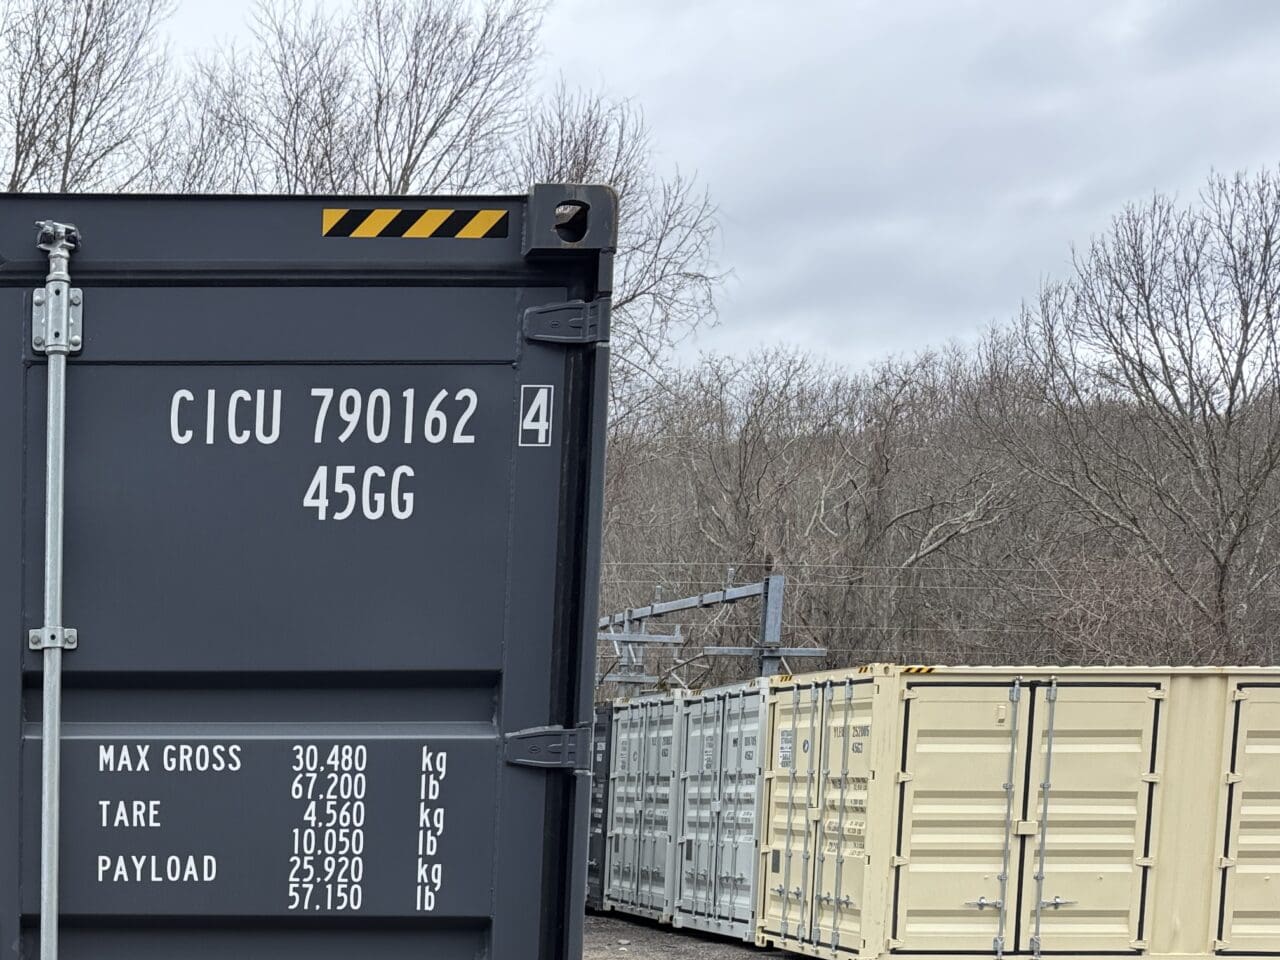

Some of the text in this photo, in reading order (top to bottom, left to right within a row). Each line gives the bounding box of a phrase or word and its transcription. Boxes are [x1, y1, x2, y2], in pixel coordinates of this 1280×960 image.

[170, 388, 549, 444] CICU 790162 4
[302, 465, 415, 520] 45GG
[98, 745, 150, 772] MAX
[162, 745, 242, 772] GROSS
[422, 746, 447, 780] kg
[420, 774, 440, 800] lb
[98, 800, 162, 827] TARE
[419, 802, 445, 836] kg
[418, 830, 437, 856] lb
[98, 855, 218, 882] PAYLOAD
[417, 858, 442, 891] kg
[416, 885, 435, 911] lb
